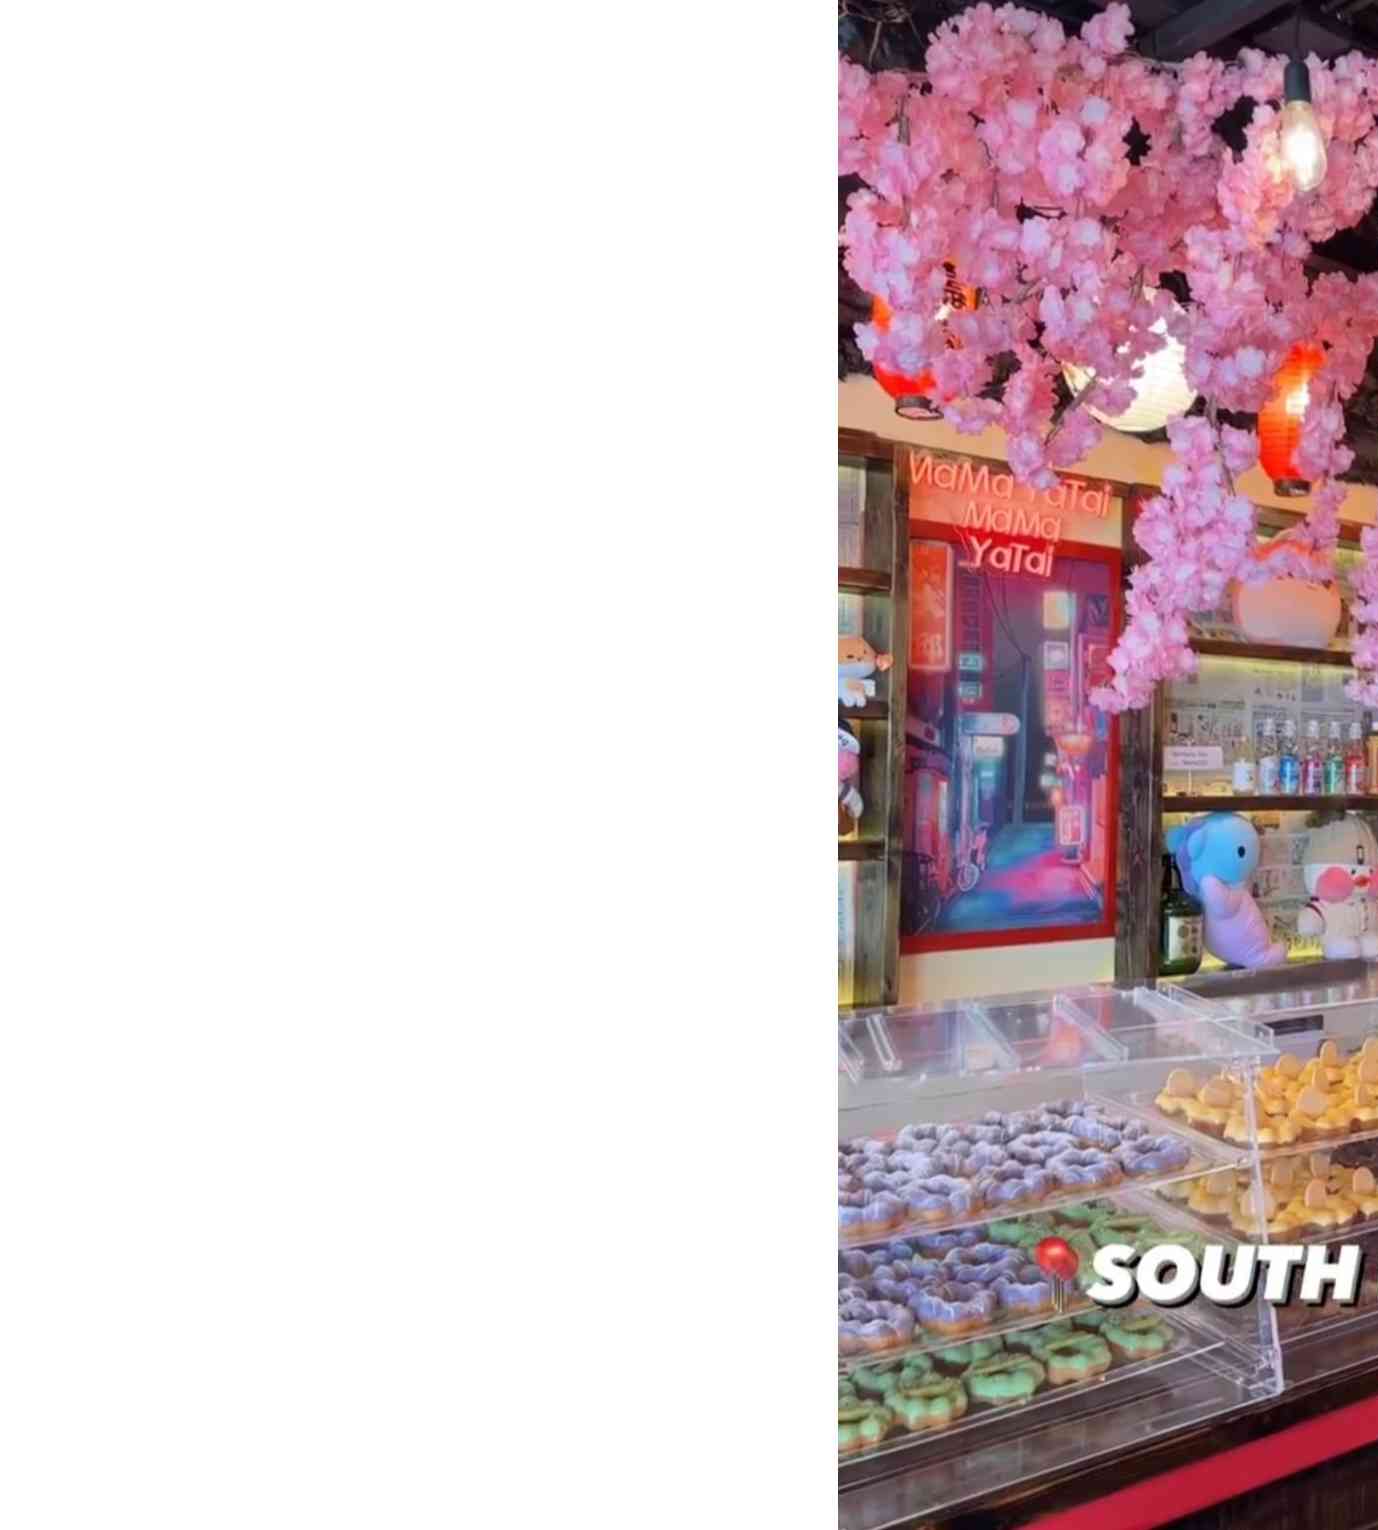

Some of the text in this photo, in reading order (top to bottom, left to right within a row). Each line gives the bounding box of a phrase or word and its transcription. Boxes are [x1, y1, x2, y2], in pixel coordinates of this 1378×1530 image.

[1029, 462, 1112, 516] aTai
[963, 501, 1061, 542] MaMa
[968, 535, 1055, 577] YaTai
